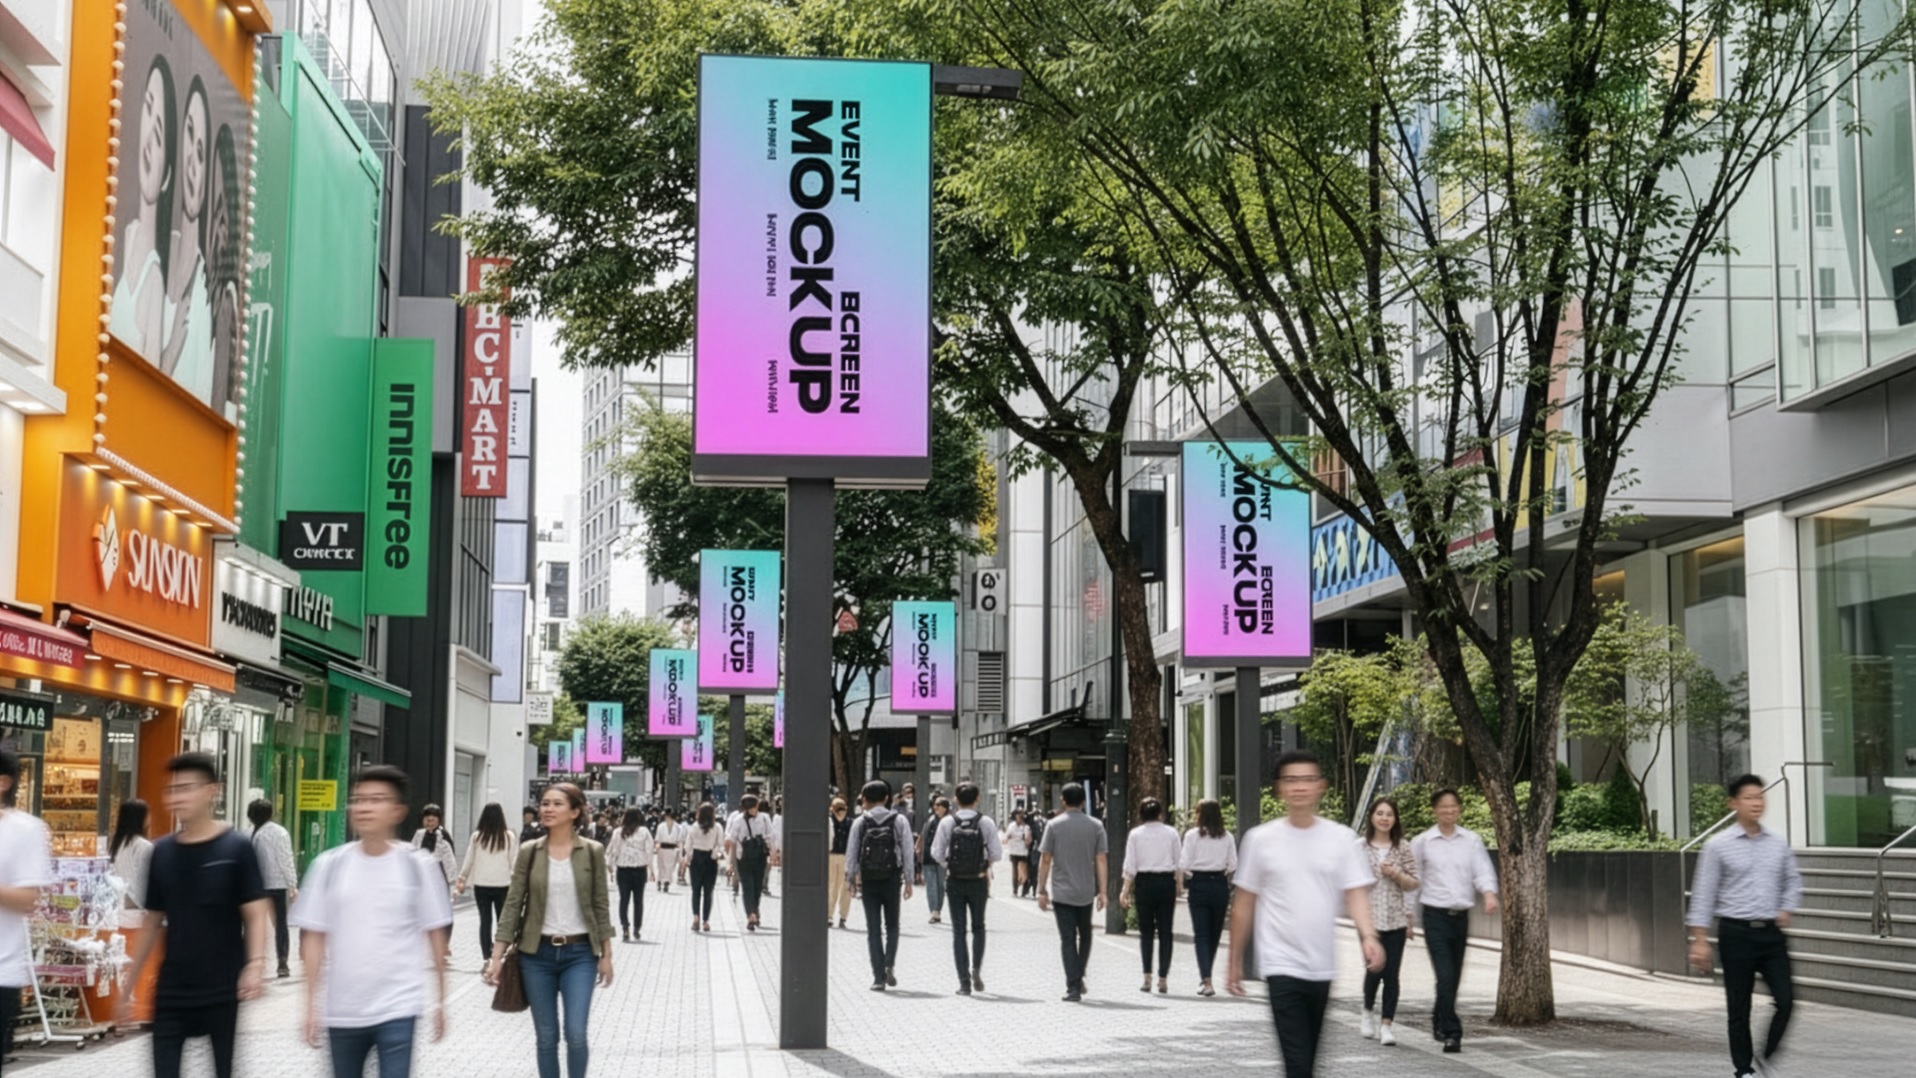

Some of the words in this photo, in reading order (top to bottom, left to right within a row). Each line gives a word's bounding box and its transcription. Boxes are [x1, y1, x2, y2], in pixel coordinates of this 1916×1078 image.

[840, 100, 861, 202] EVENT
[789, 99, 835, 414] MOCKUP
[301, 522, 348, 546] VT
[1233, 464, 1257, 634] MOCKUP
